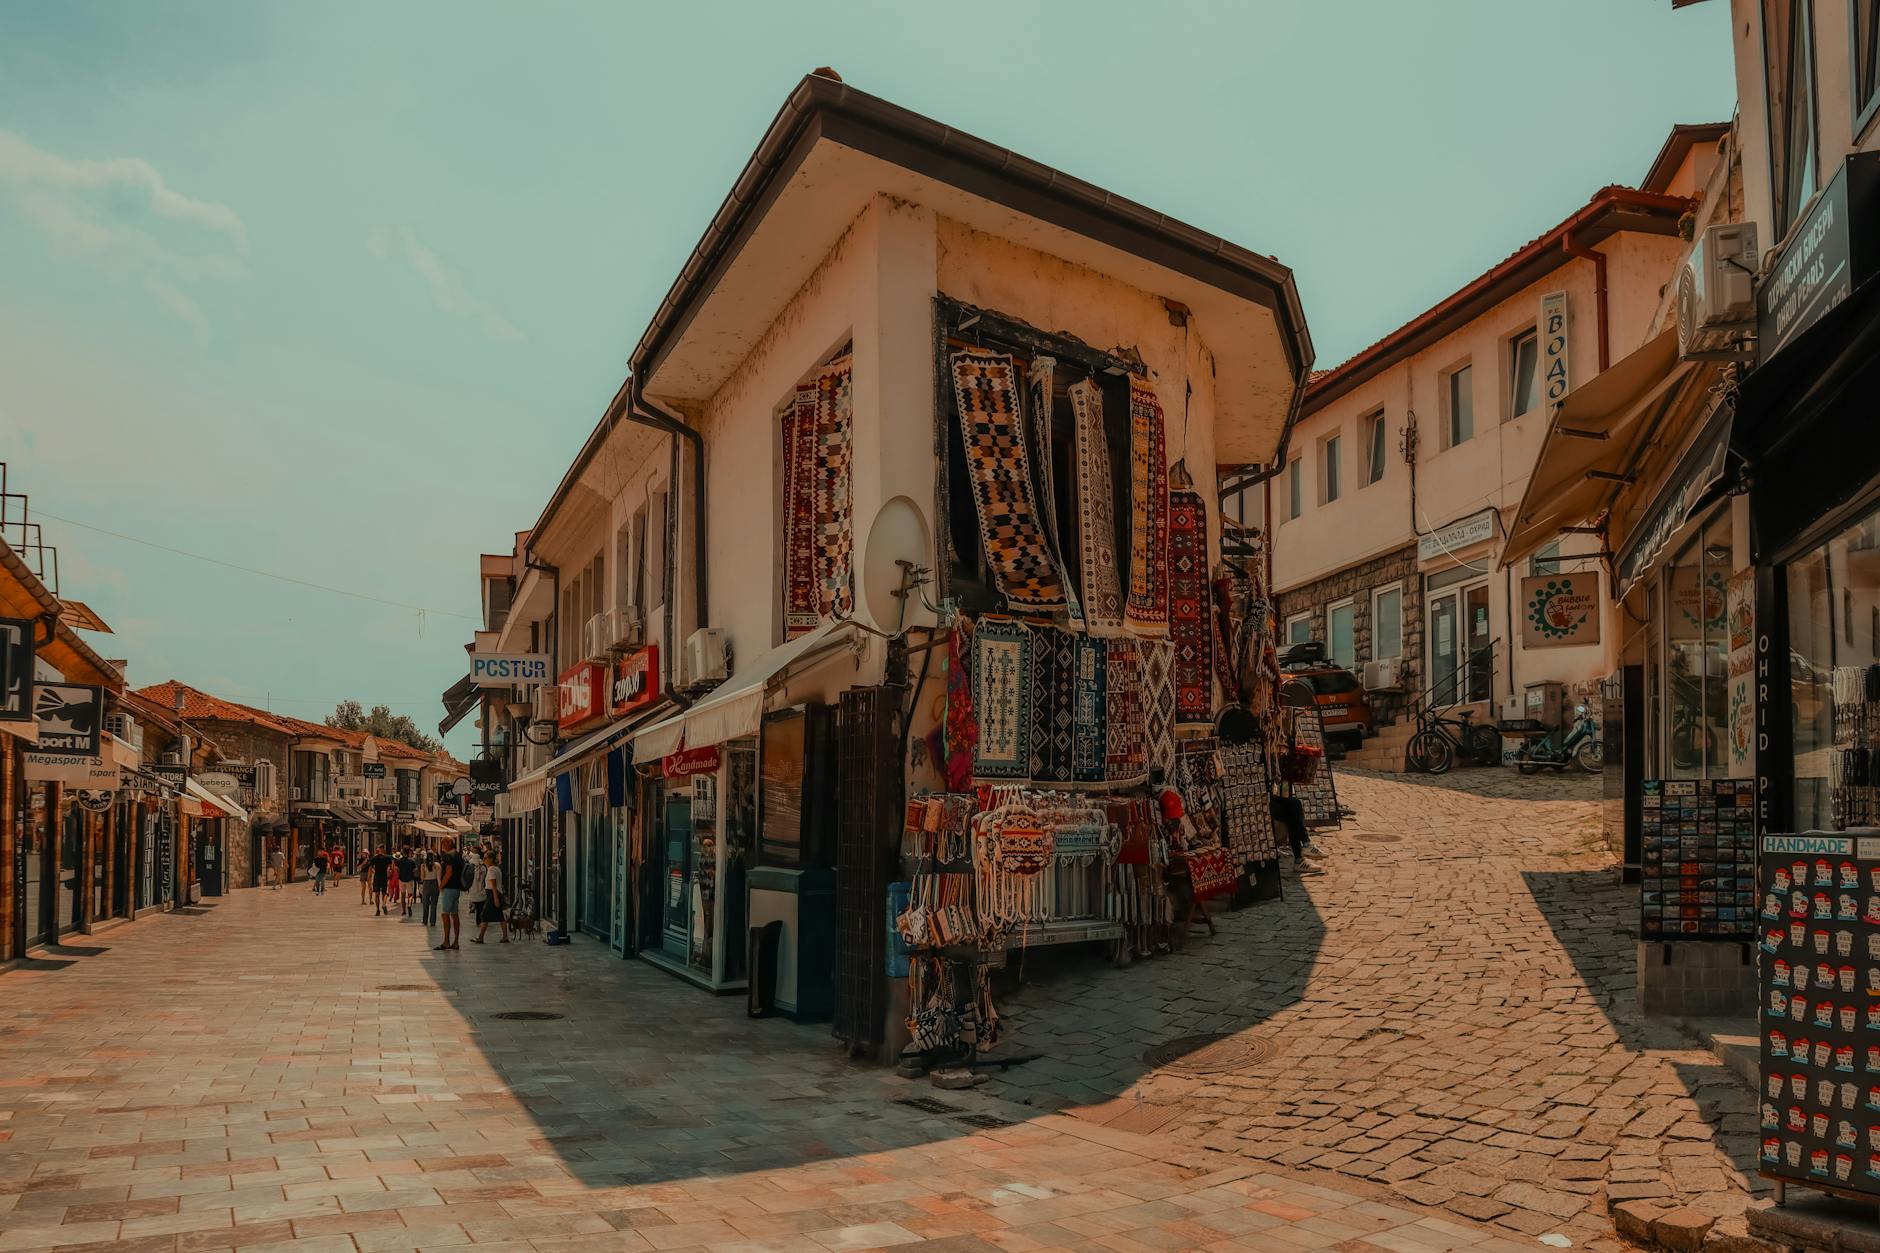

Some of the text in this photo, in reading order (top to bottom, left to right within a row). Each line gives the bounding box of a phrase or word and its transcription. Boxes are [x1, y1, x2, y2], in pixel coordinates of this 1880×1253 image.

[1803, 200, 1834, 262] БИСЕРИ
[1776, 252, 1825, 336] OHRID PEARLS
[1547, 314, 1566, 400] ВОДО
[1758, 634, 1769, 751] OHRID
[75, 737, 90, 749] M
[27, 754, 87, 766] Megasport
[668, 754, 718, 775] Handmade
[161, 772, 184, 782] STORE
[1765, 837, 1849, 854] HANDMADE
